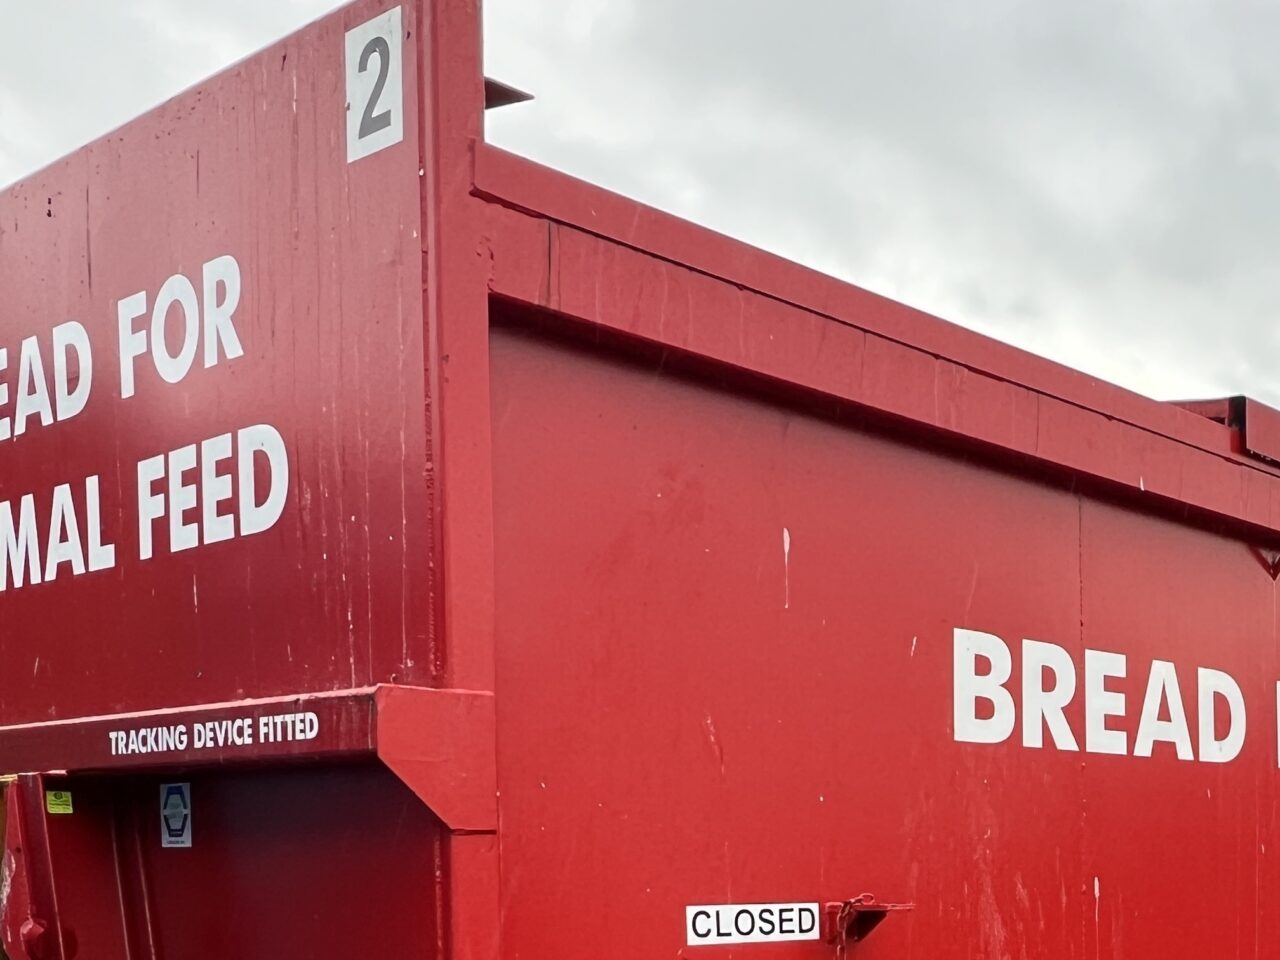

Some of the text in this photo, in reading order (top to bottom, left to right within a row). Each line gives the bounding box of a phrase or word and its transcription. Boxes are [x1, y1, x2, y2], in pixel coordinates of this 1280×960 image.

[357, 36, 392, 141] 2
[117, 255, 245, 399] FOR
[137, 424, 289, 560] FEED
[109, 711, 319, 755] TRACKING DEVICE FITTED
[953, 627, 1247, 763] BREAD
[692, 907, 816, 938] CLOSED
